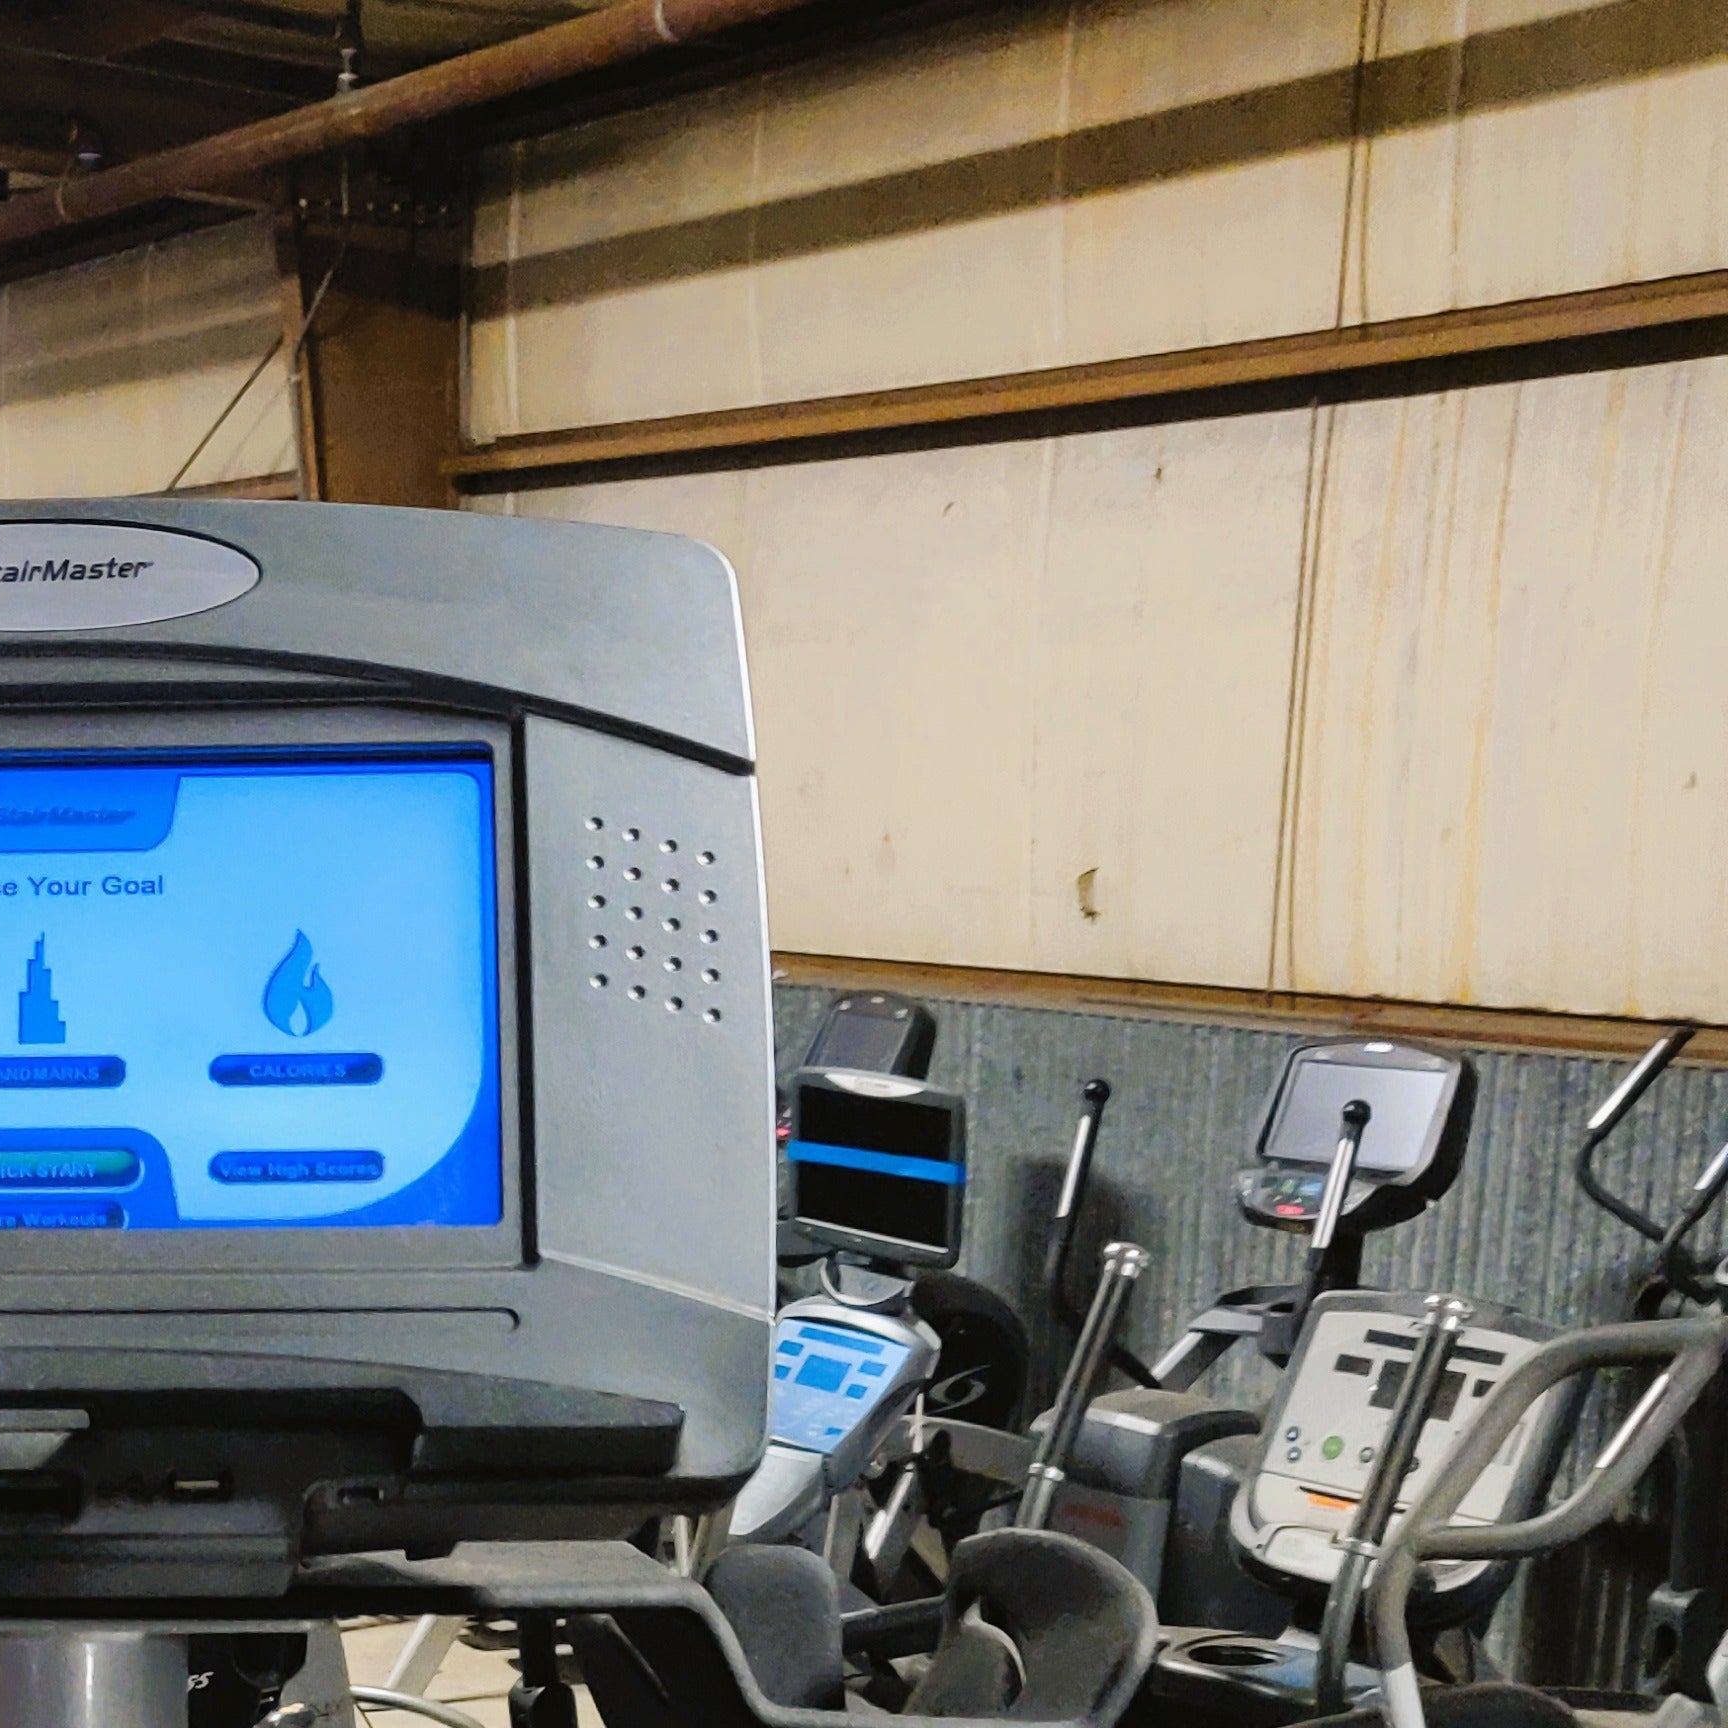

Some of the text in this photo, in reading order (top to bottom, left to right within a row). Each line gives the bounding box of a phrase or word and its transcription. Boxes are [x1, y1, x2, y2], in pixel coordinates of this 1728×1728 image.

[27, 876, 92, 896] Your
[101, 874, 164, 895] Goal
[249, 1063, 347, 1078] CALORIES
[36, 1161, 97, 1179] START
[22, 1211, 108, 1227] Workouts
